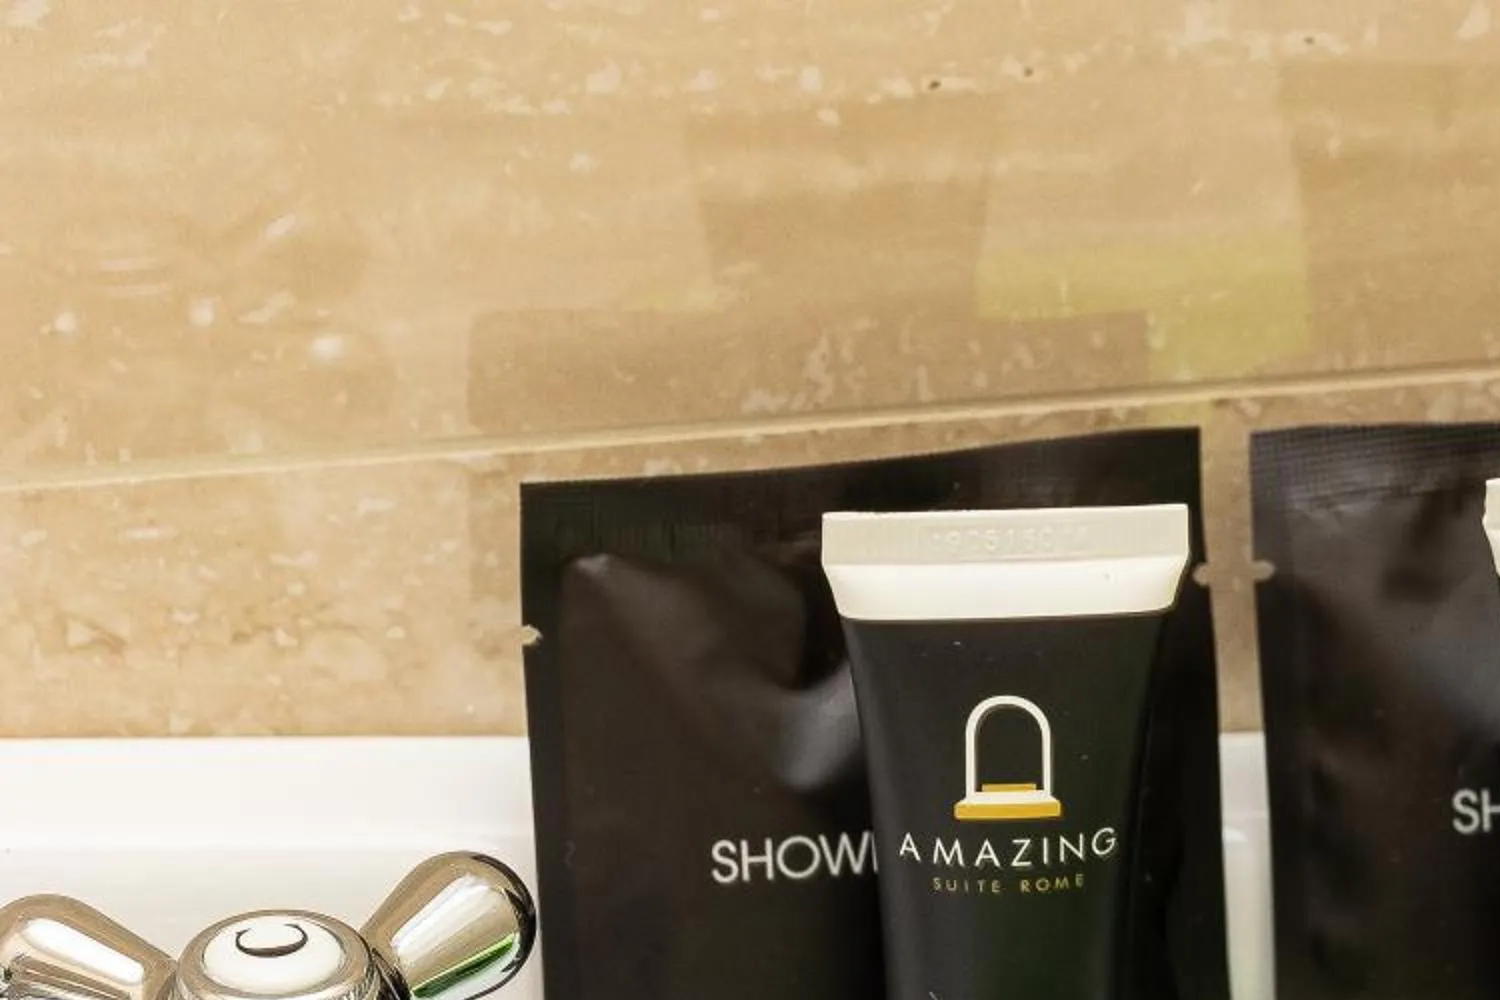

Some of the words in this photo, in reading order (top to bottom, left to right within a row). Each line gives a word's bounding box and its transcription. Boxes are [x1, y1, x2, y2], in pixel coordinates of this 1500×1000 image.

[711, 830, 879, 883] SHOW
[899, 827, 1118, 869] AMAZING
[932, 876, 1001, 893] SUITE
[1021, 872, 1085, 893] ROME
